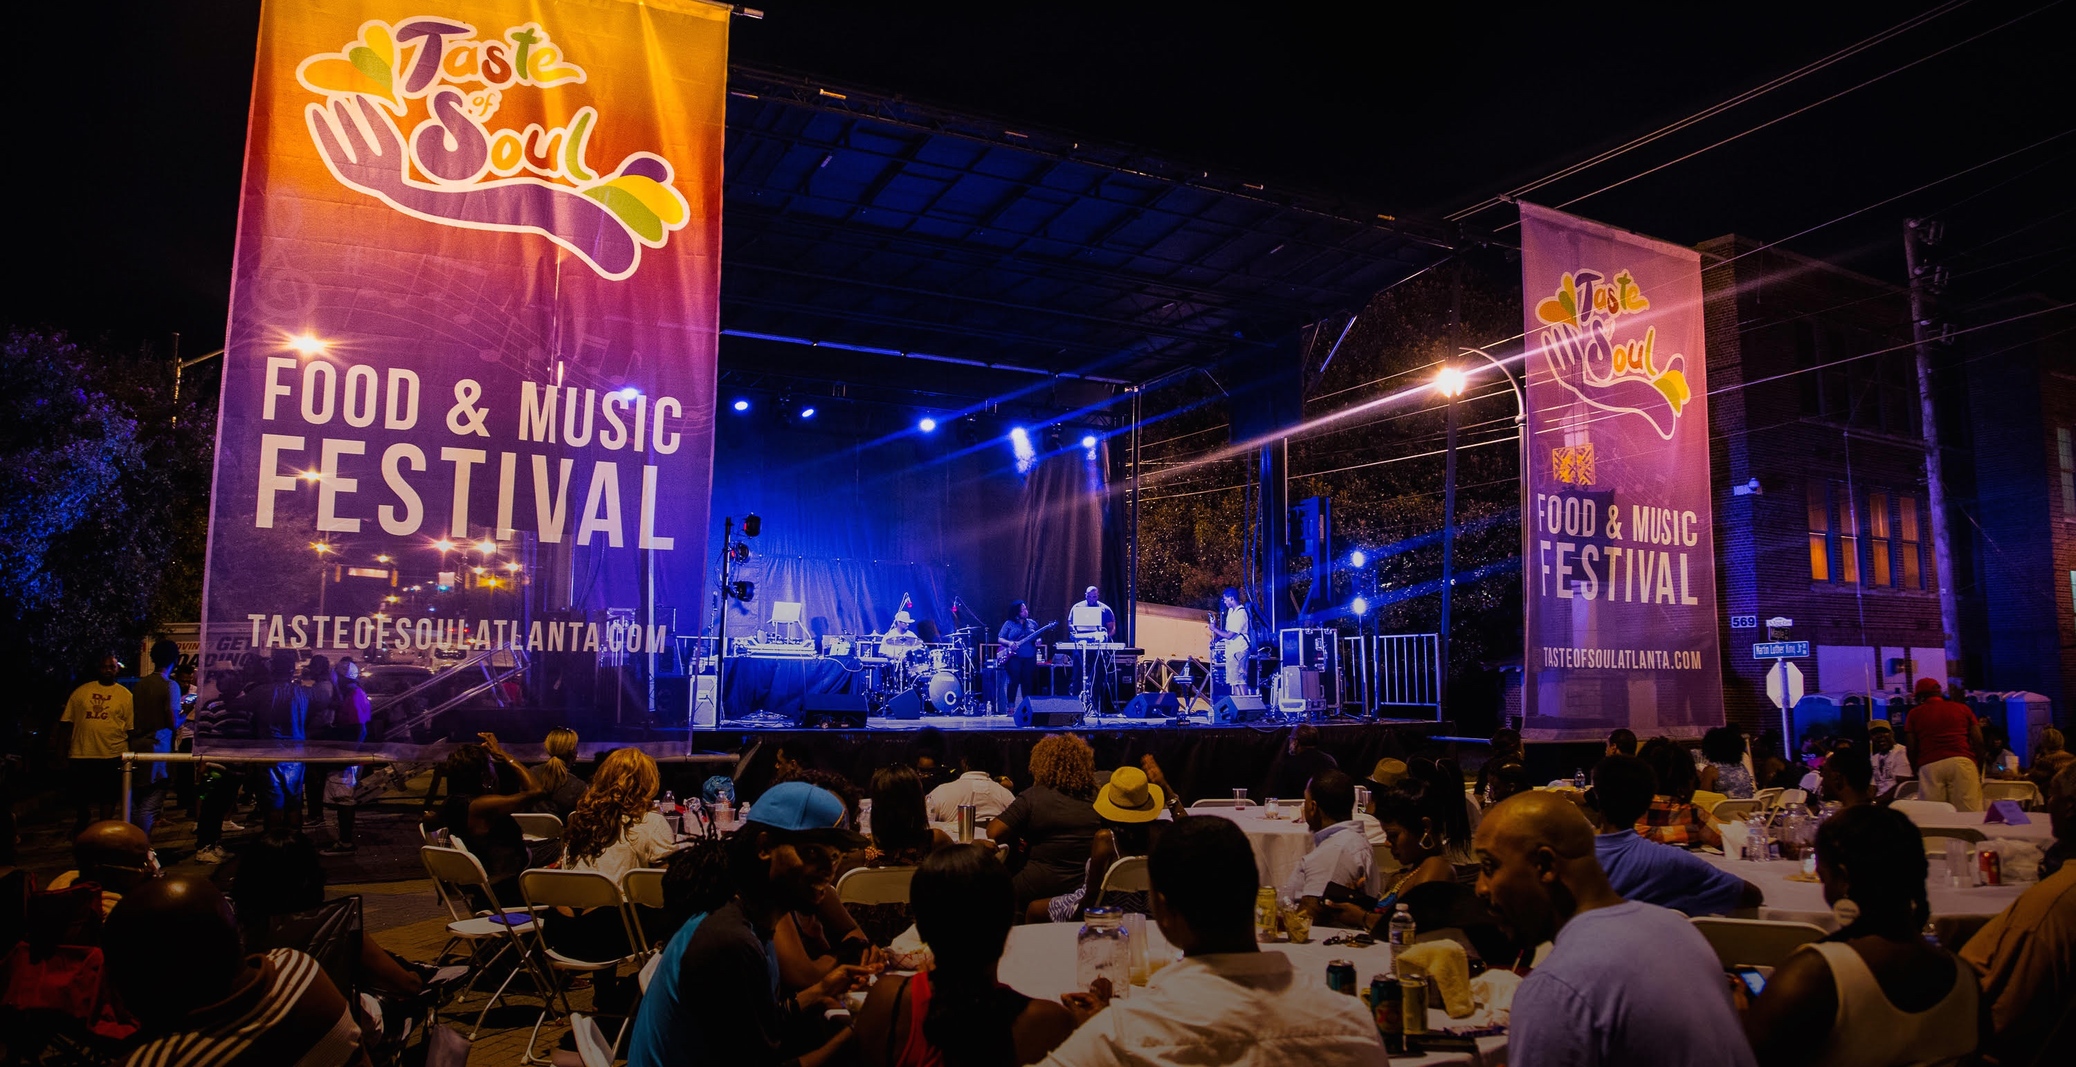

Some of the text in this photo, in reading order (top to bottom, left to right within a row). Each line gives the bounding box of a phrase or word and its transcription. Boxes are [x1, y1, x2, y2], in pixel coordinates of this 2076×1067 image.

[395, 19, 583, 94] Taste
[471, 92, 494, 116] of
[415, 90, 594, 182] Soul
[1575, 272, 1648, 323] Taste
[1587, 319, 1656, 382] Soul
[262, 356, 683, 455] FOOD & MUSIC
[255, 433, 675, 551] FESTIVAL
[1538, 493, 1698, 547] FOOD & MUSIC
[1540, 540, 1698, 606] FESTIVAL
[247, 613, 667, 654] TASTEOFSOULATLANTA.COM
[1733, 617, 1755, 627] 569
[1543, 646, 1702, 670] TASTEOFSOULATLANTA.COM
